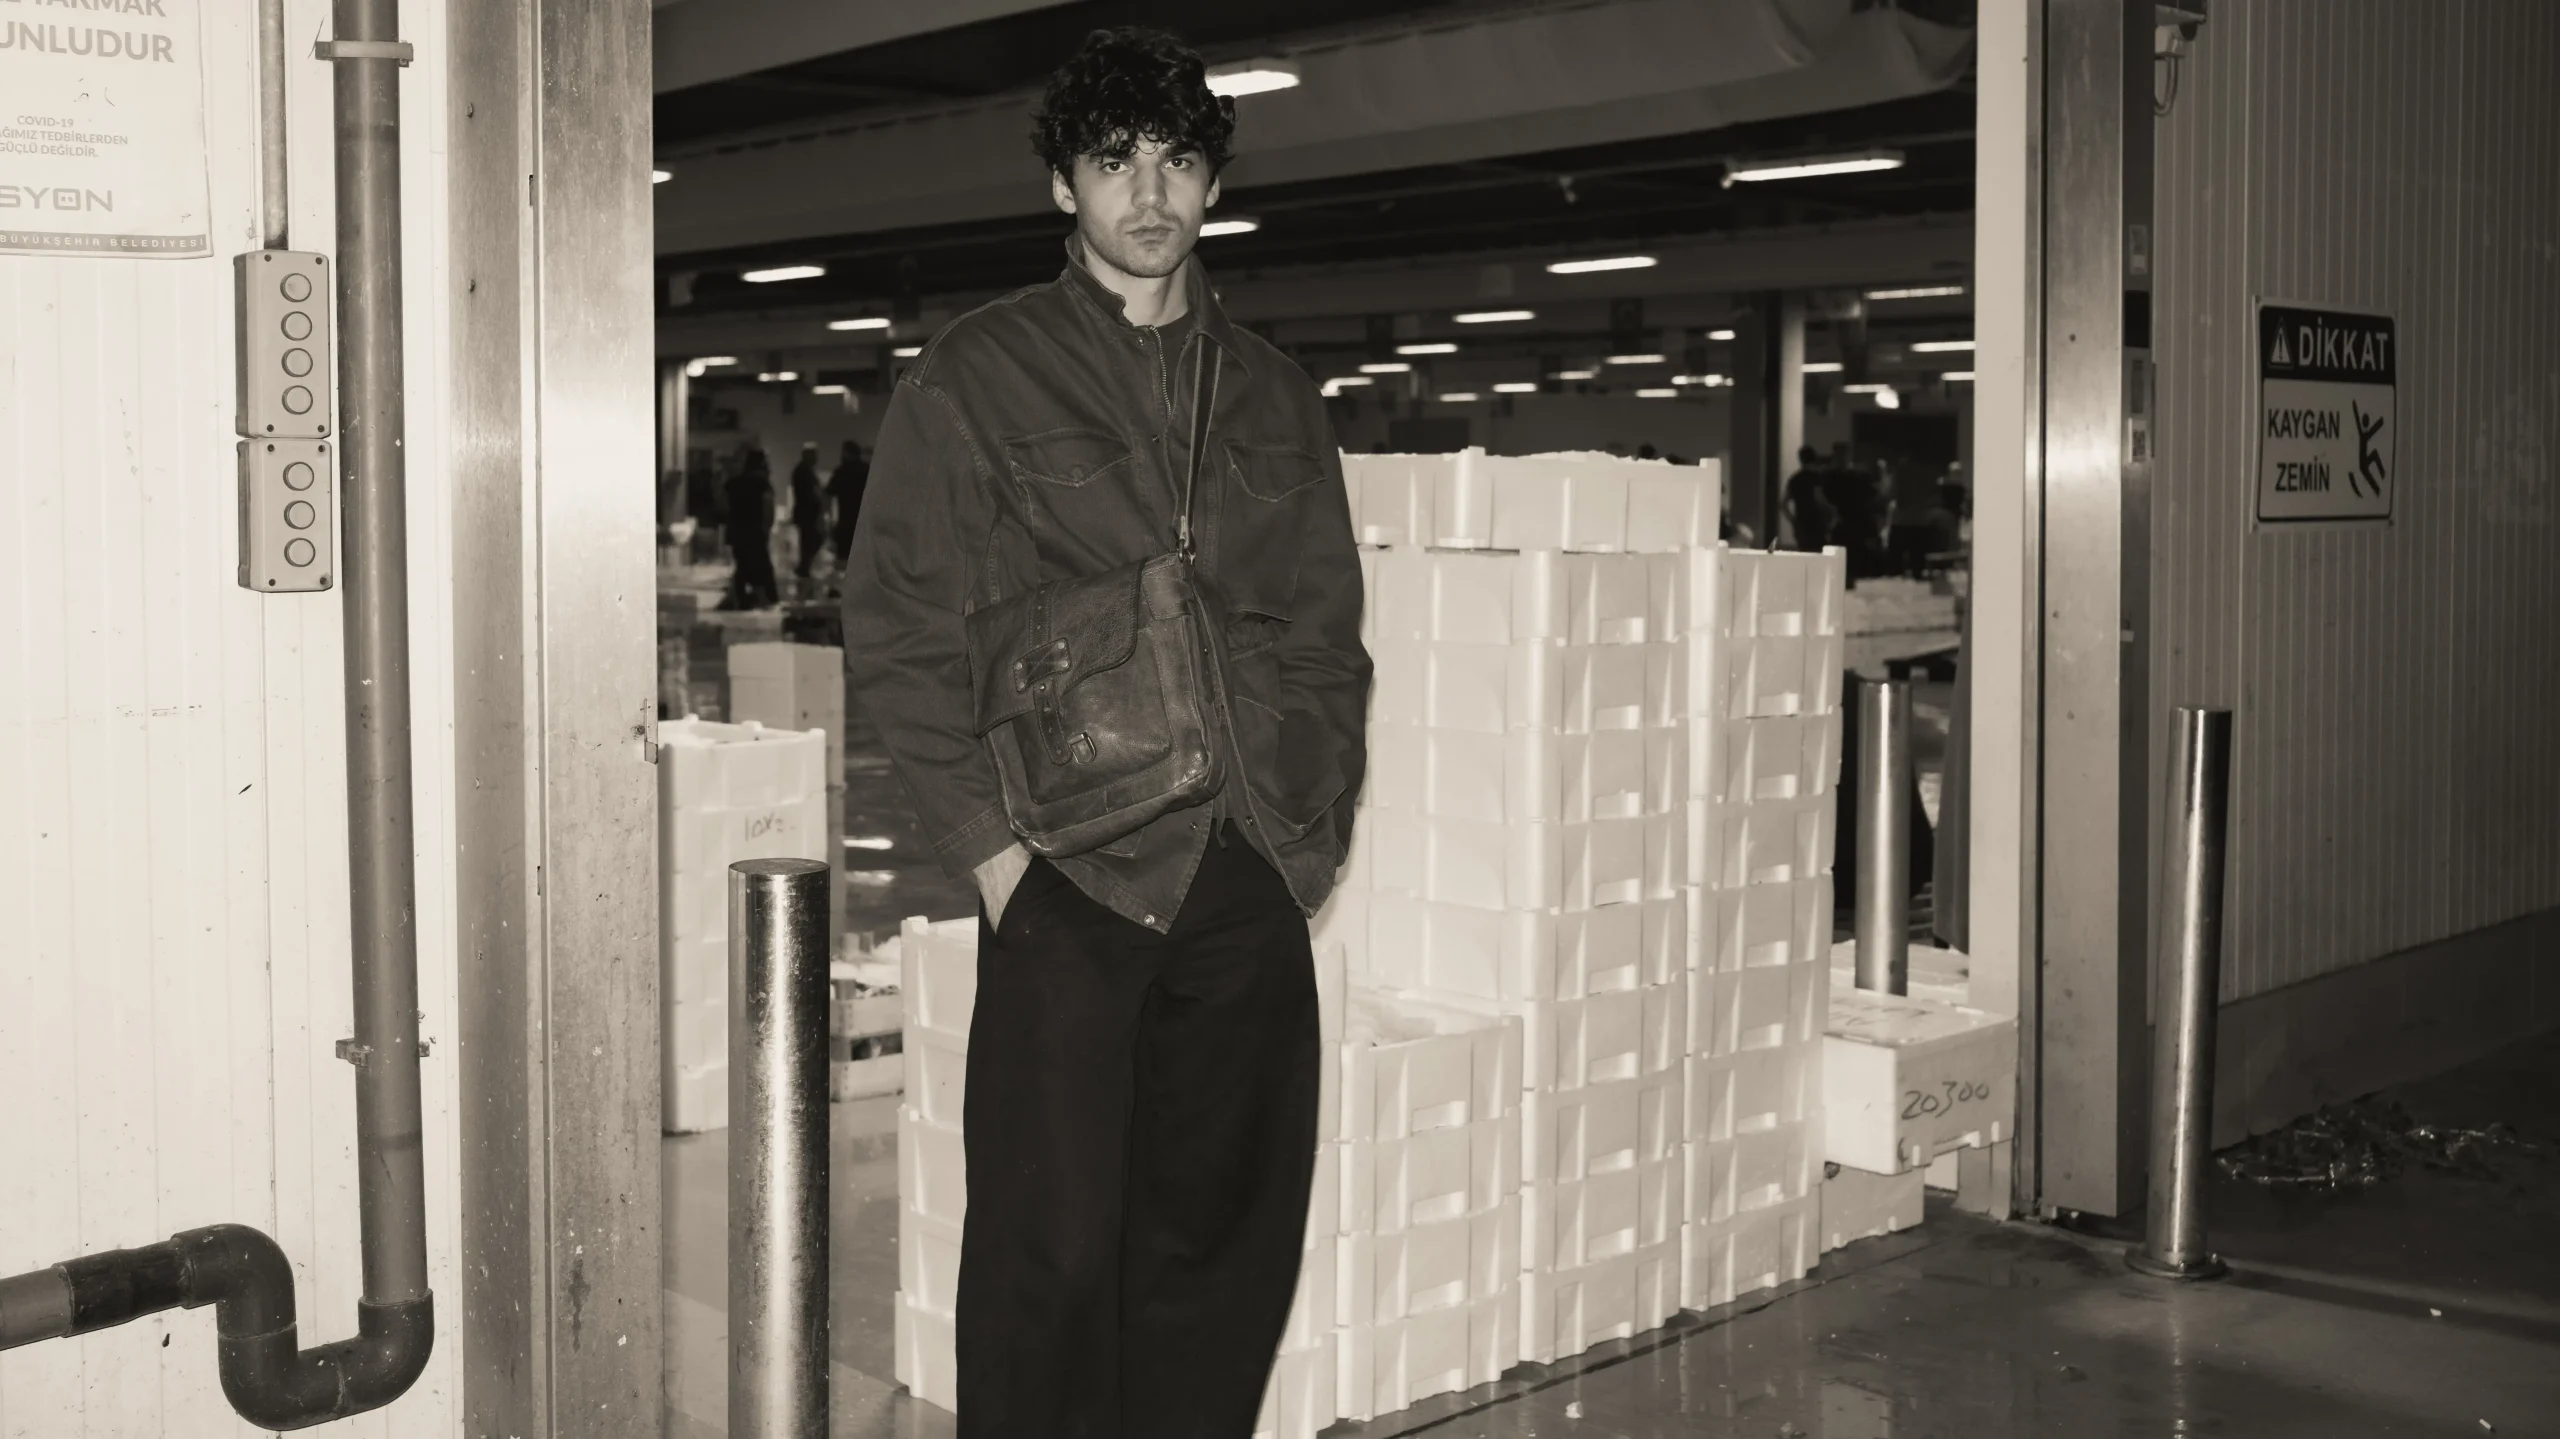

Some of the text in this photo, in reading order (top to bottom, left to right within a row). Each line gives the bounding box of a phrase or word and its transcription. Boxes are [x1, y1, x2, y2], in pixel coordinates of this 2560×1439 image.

[0, 126, 128, 145] ĞIMIZ TEDBİRLERDEN
[17, 115, 74, 128] COVID-19
[0, 234, 100, 246] BÜYÜKŞEHİR
[2299, 317, 2388, 371] DİKKAT
[2267, 408, 2340, 439] KAYGAN
[2275, 455, 2330, 492] ZEMİN
[1901, 1080, 1990, 1121] 20300
